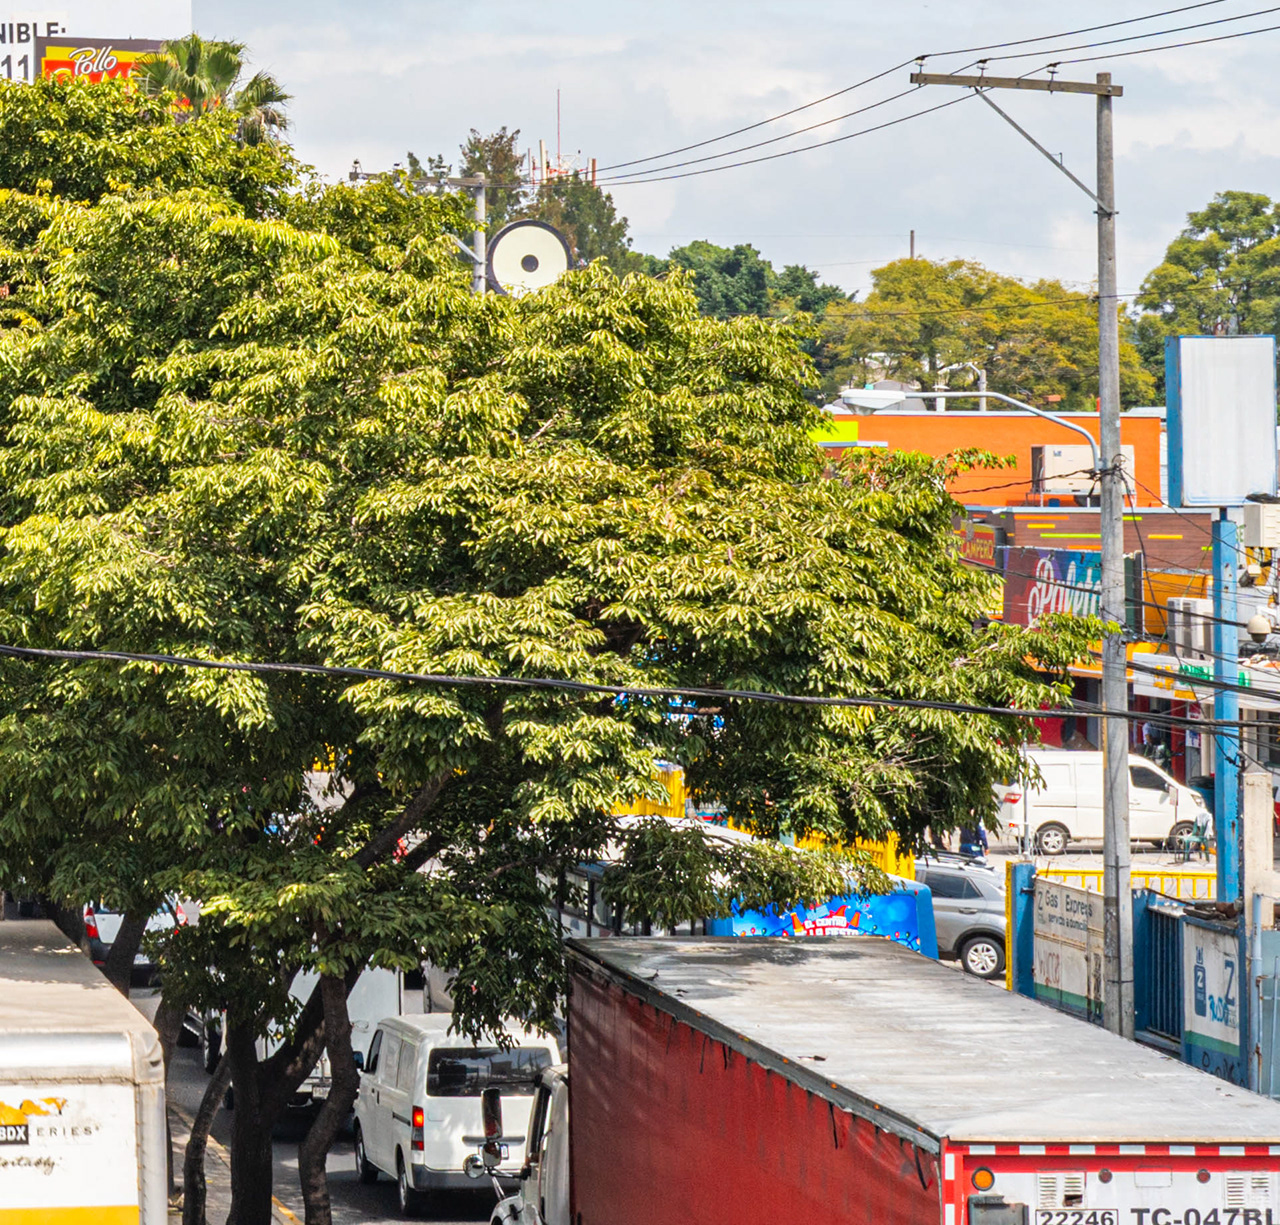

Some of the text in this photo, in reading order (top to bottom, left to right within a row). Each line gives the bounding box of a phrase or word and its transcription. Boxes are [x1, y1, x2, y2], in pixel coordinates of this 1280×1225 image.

[69, 46, 118, 75] Pollo
[1045, 890, 1058, 908] Gas
[1065, 894, 1093, 917] Express
